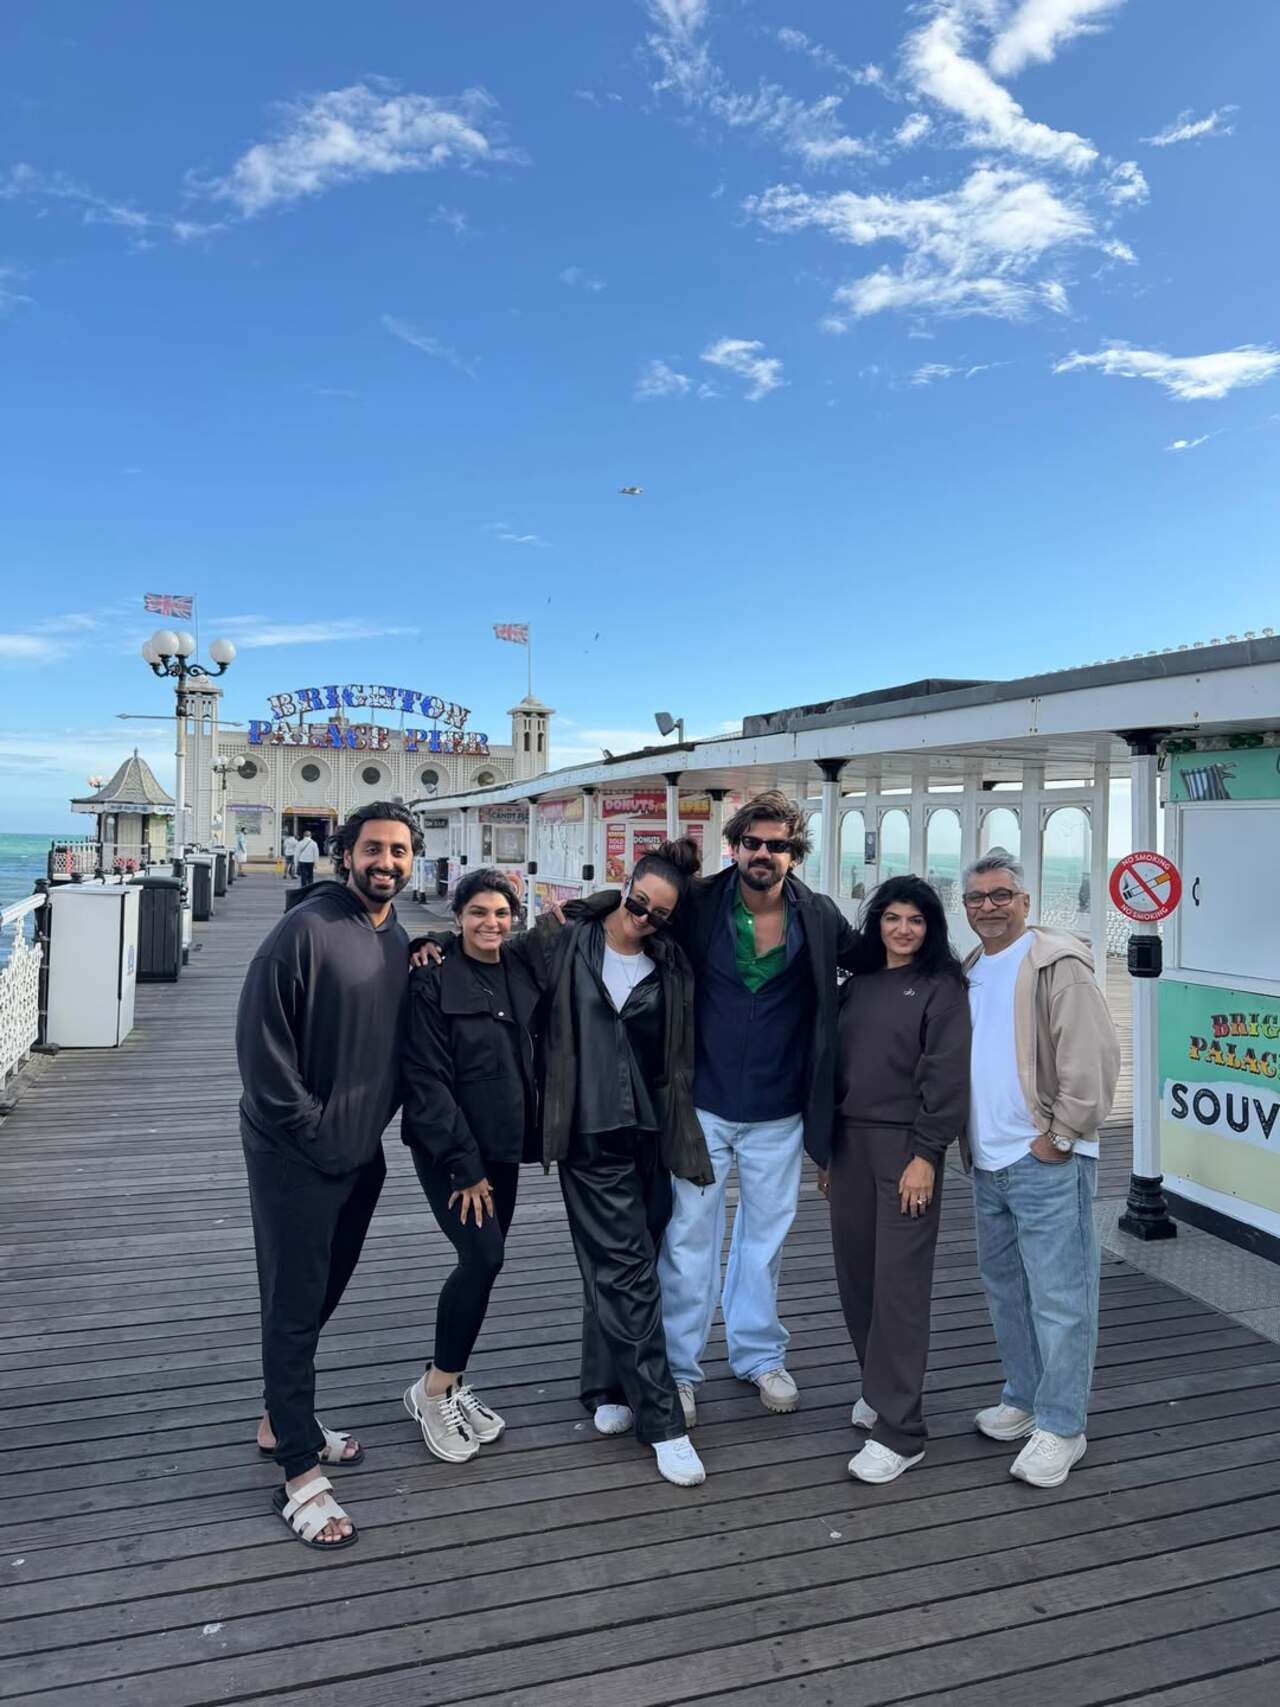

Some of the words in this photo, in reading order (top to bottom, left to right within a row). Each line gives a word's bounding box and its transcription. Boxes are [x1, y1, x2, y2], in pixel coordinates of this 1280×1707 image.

[267, 684, 472, 730] BRIGHTON
[248, 718, 390, 751] PALACE
[404, 727, 490, 756] PIER
[604, 799, 656, 811] DONUTS
[1122, 856, 1135, 866] NO
[1135, 854, 1171, 870] SMOKING
[1121, 904, 1133, 915] NO
[1133, 906, 1168, 920] SMOKING
[1210, 1012, 1280, 1039] BRIG
[1188, 1035, 1280, 1080] PALAC
[1171, 1083, 1280, 1140] SOUV
